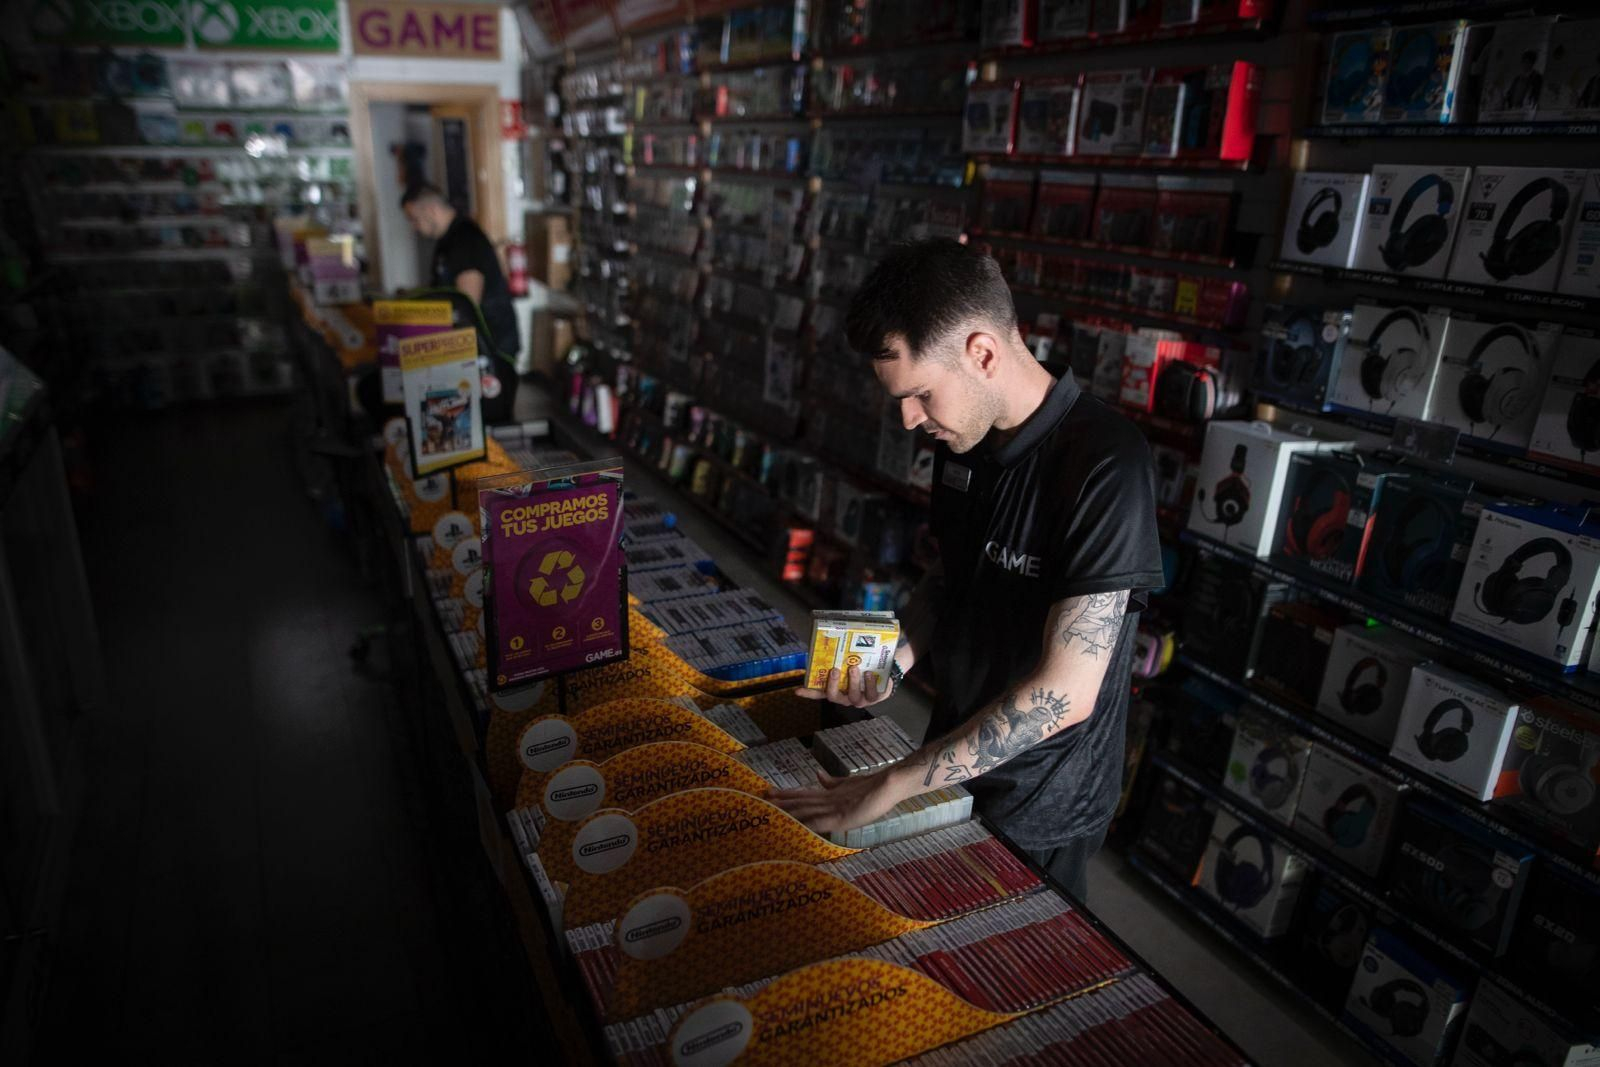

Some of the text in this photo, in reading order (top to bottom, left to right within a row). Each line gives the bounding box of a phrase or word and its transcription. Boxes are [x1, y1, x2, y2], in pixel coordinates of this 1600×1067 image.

[358, 9, 497, 51] GAME
[501, 493, 608, 523] COMPRAMOS
[501, 506, 609, 538] TUS JUEGOS
[985, 540, 1041, 578] GAME
[582, 715, 671, 740] SEMINUEVOS
[582, 722, 692, 754] GARANTIZADOS
[530, 739, 568, 754] Nintendo
[613, 760, 707, 785] SEMINUEVOS
[614, 766, 730, 802] GARANTIZADOS
[554, 786, 596, 800] Nintendo
[646, 806, 748, 837] SEMINUEVOS
[647, 815, 770, 852] GARANTIZADOS
[583, 838, 626, 854] Nintendo
[697, 881, 807, 918] SEMINUEVOS
[697, 888, 832, 934] GARANTIZADOS
[759, 986, 907, 1042] GARANTIZADOS
